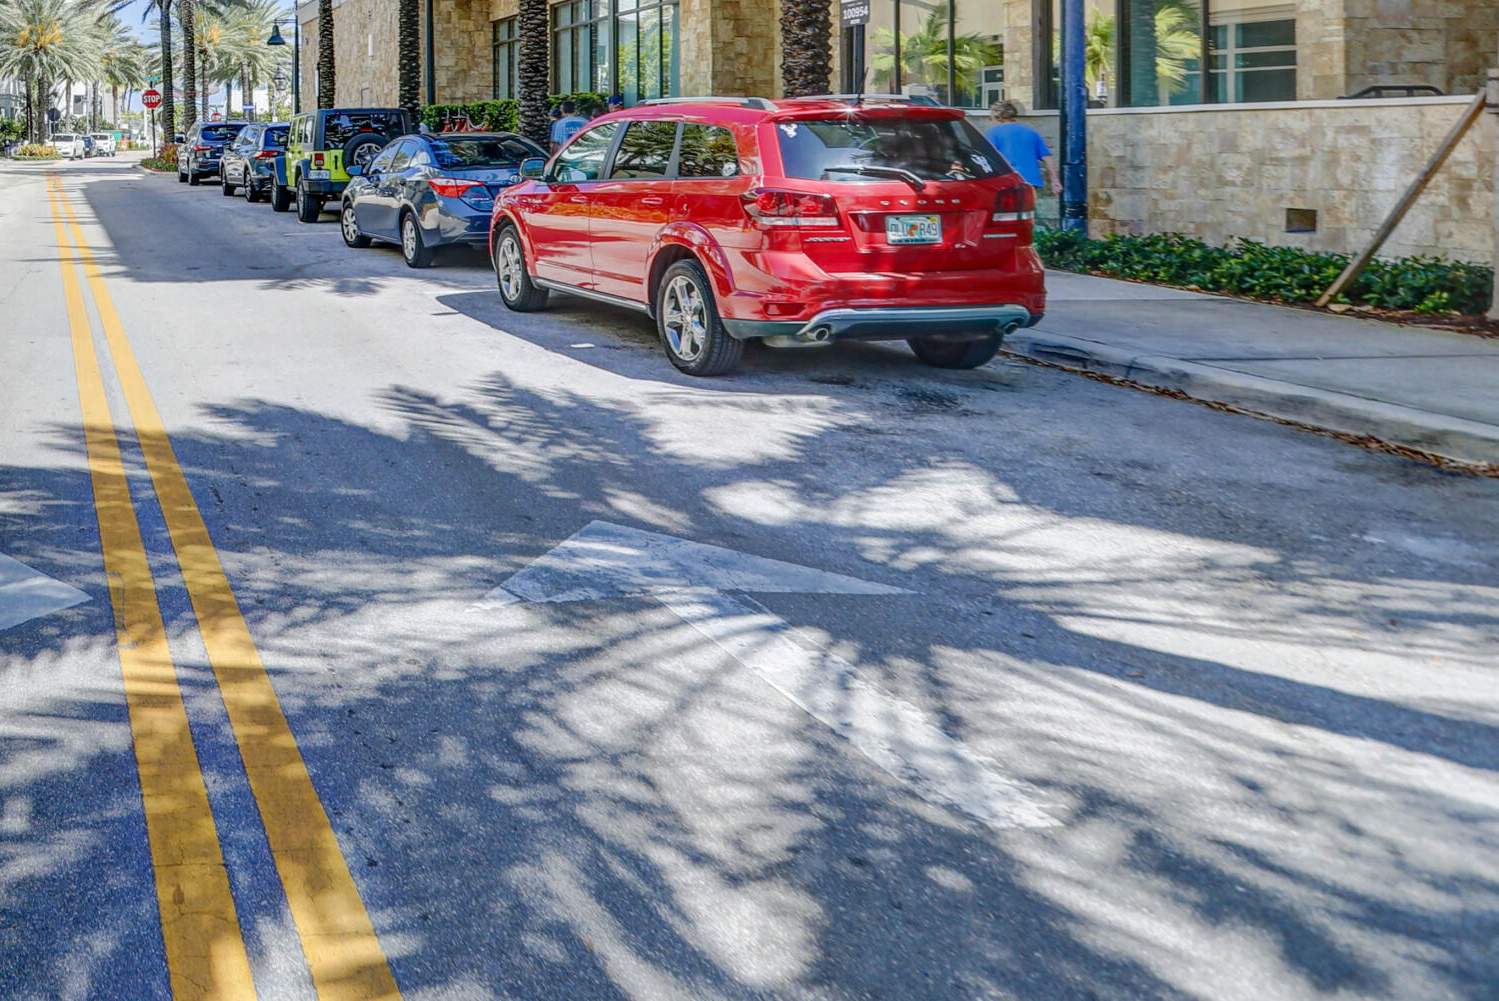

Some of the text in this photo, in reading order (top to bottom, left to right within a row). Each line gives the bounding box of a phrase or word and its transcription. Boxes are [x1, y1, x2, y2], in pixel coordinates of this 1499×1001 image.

[842, 4, 869, 20] 100954
[143, 94, 160, 103] STOP
[919, 222, 937, 236] R49
